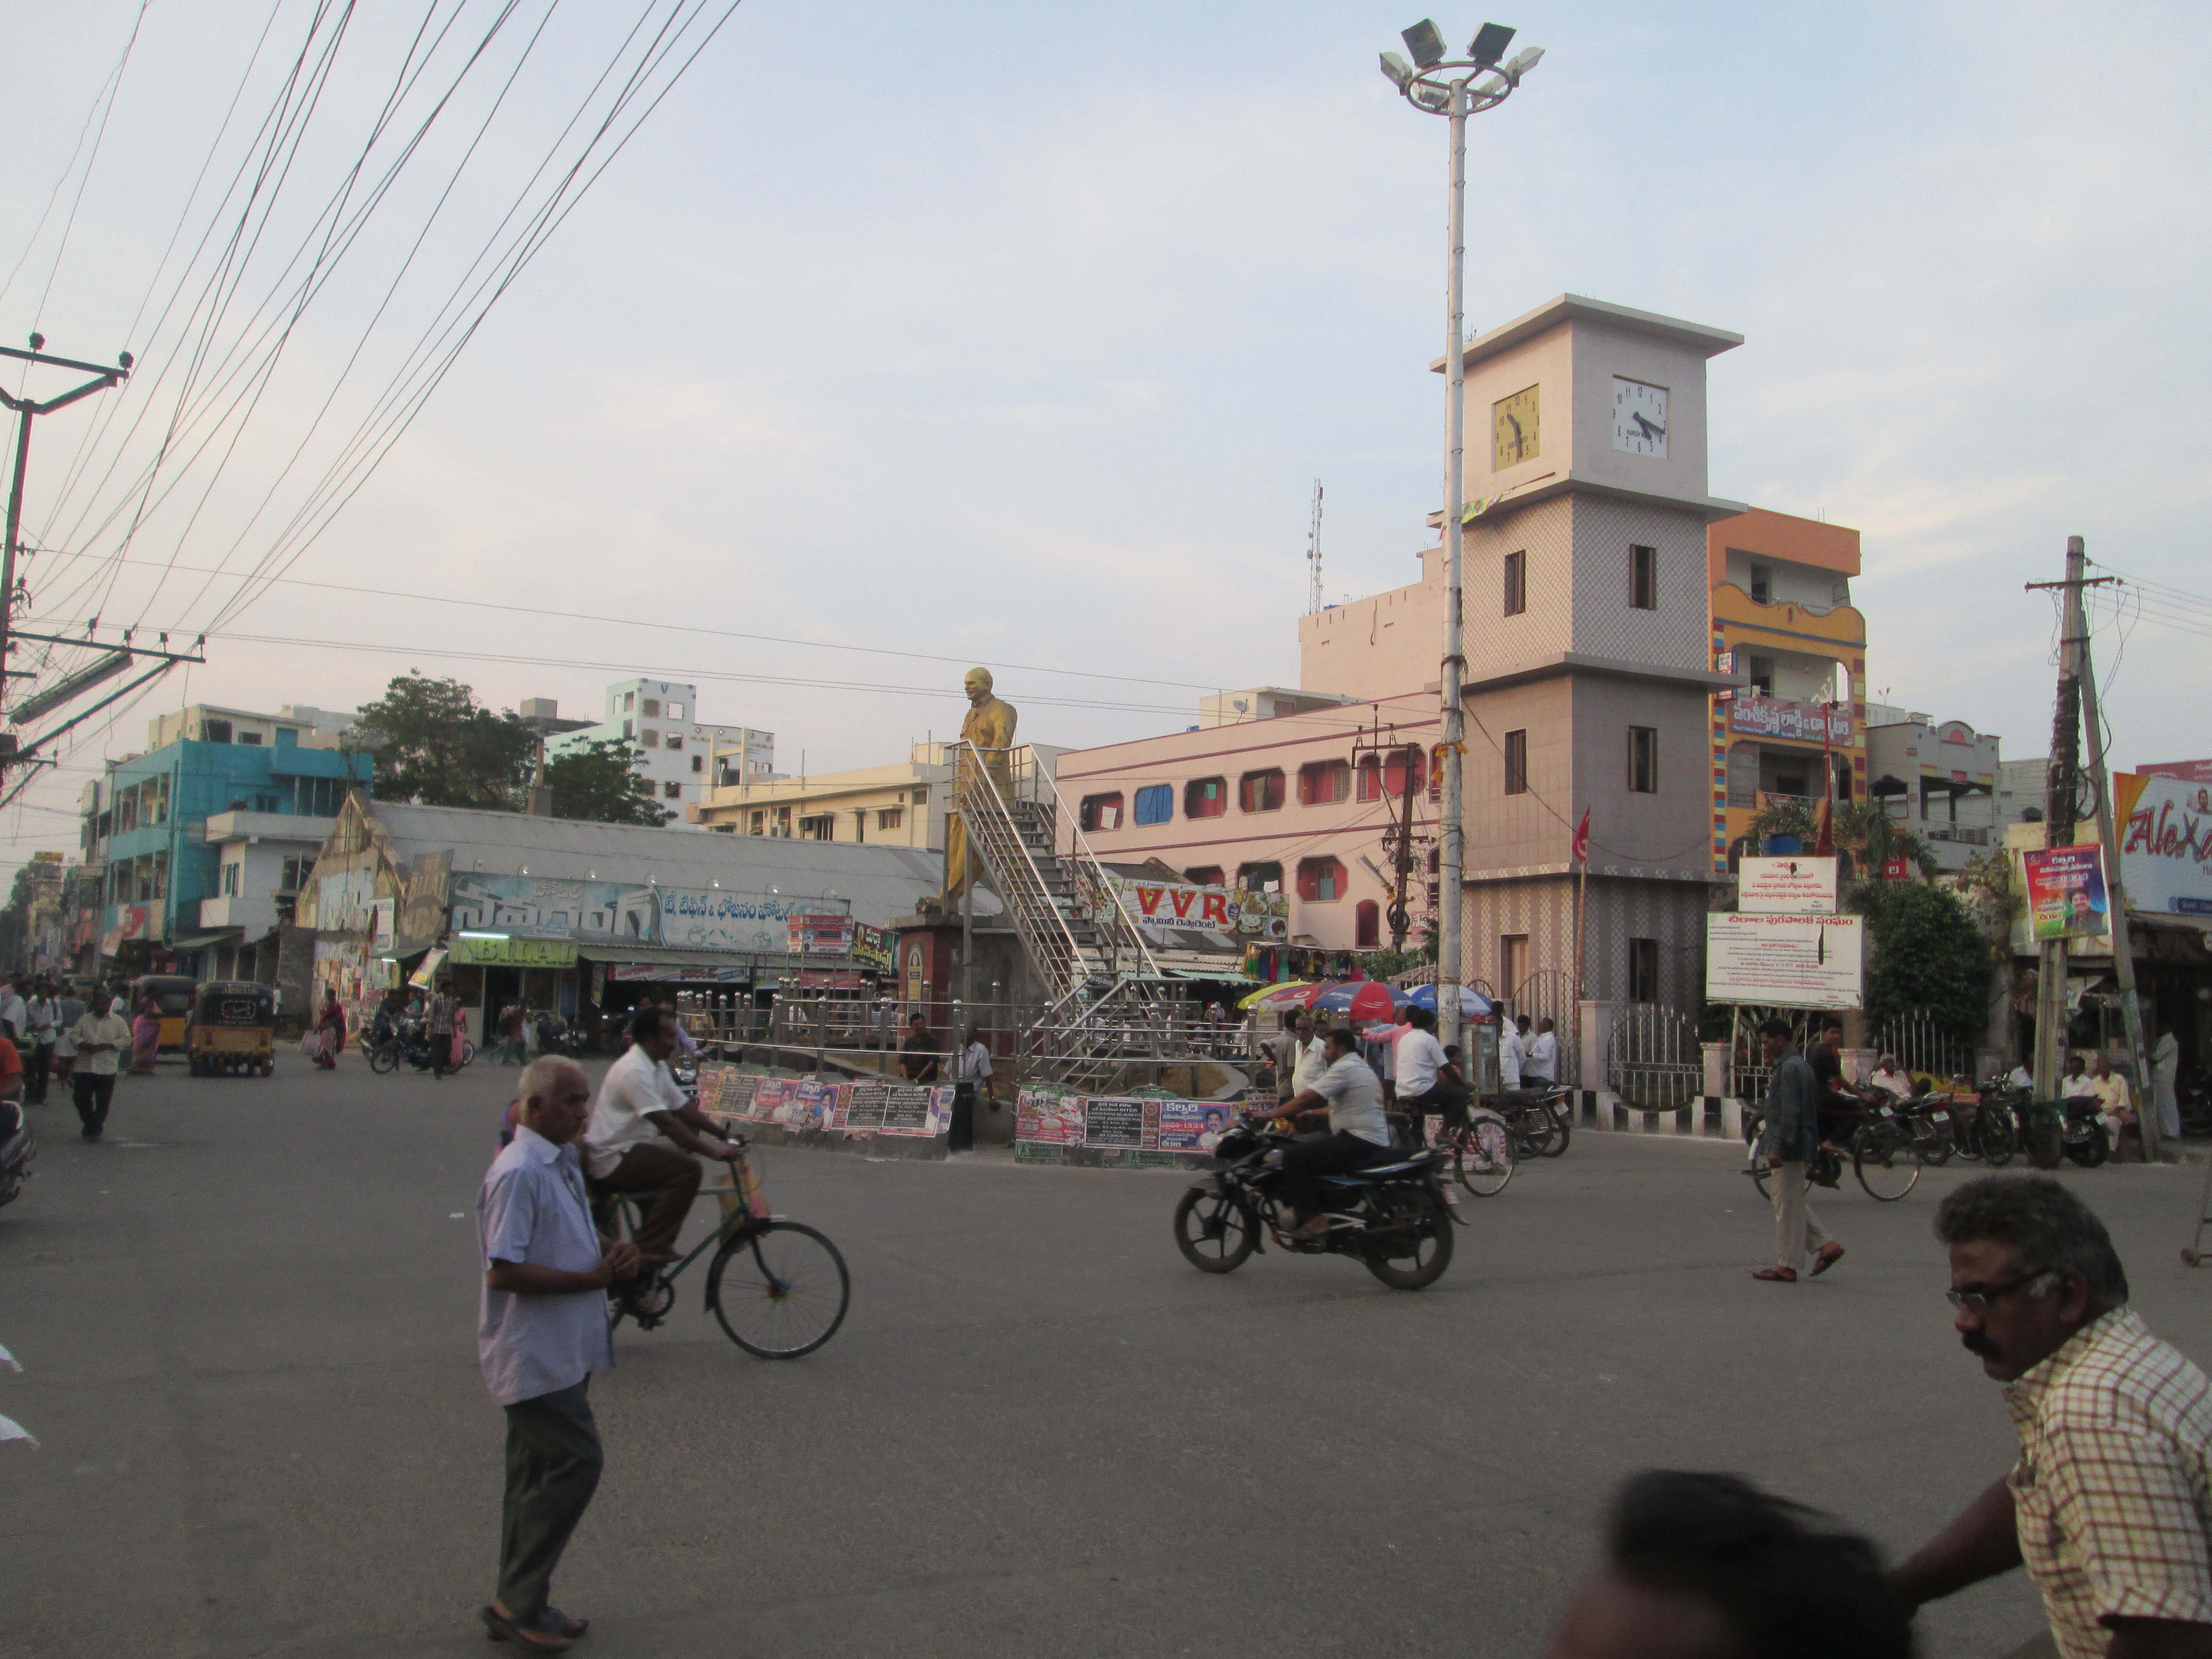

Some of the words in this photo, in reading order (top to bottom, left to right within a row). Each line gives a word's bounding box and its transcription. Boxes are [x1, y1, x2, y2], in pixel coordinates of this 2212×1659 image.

[1625, 387, 1631, 398] 11
[1637, 386, 1643, 398] 12
[1617, 393, 1622, 405] 10
